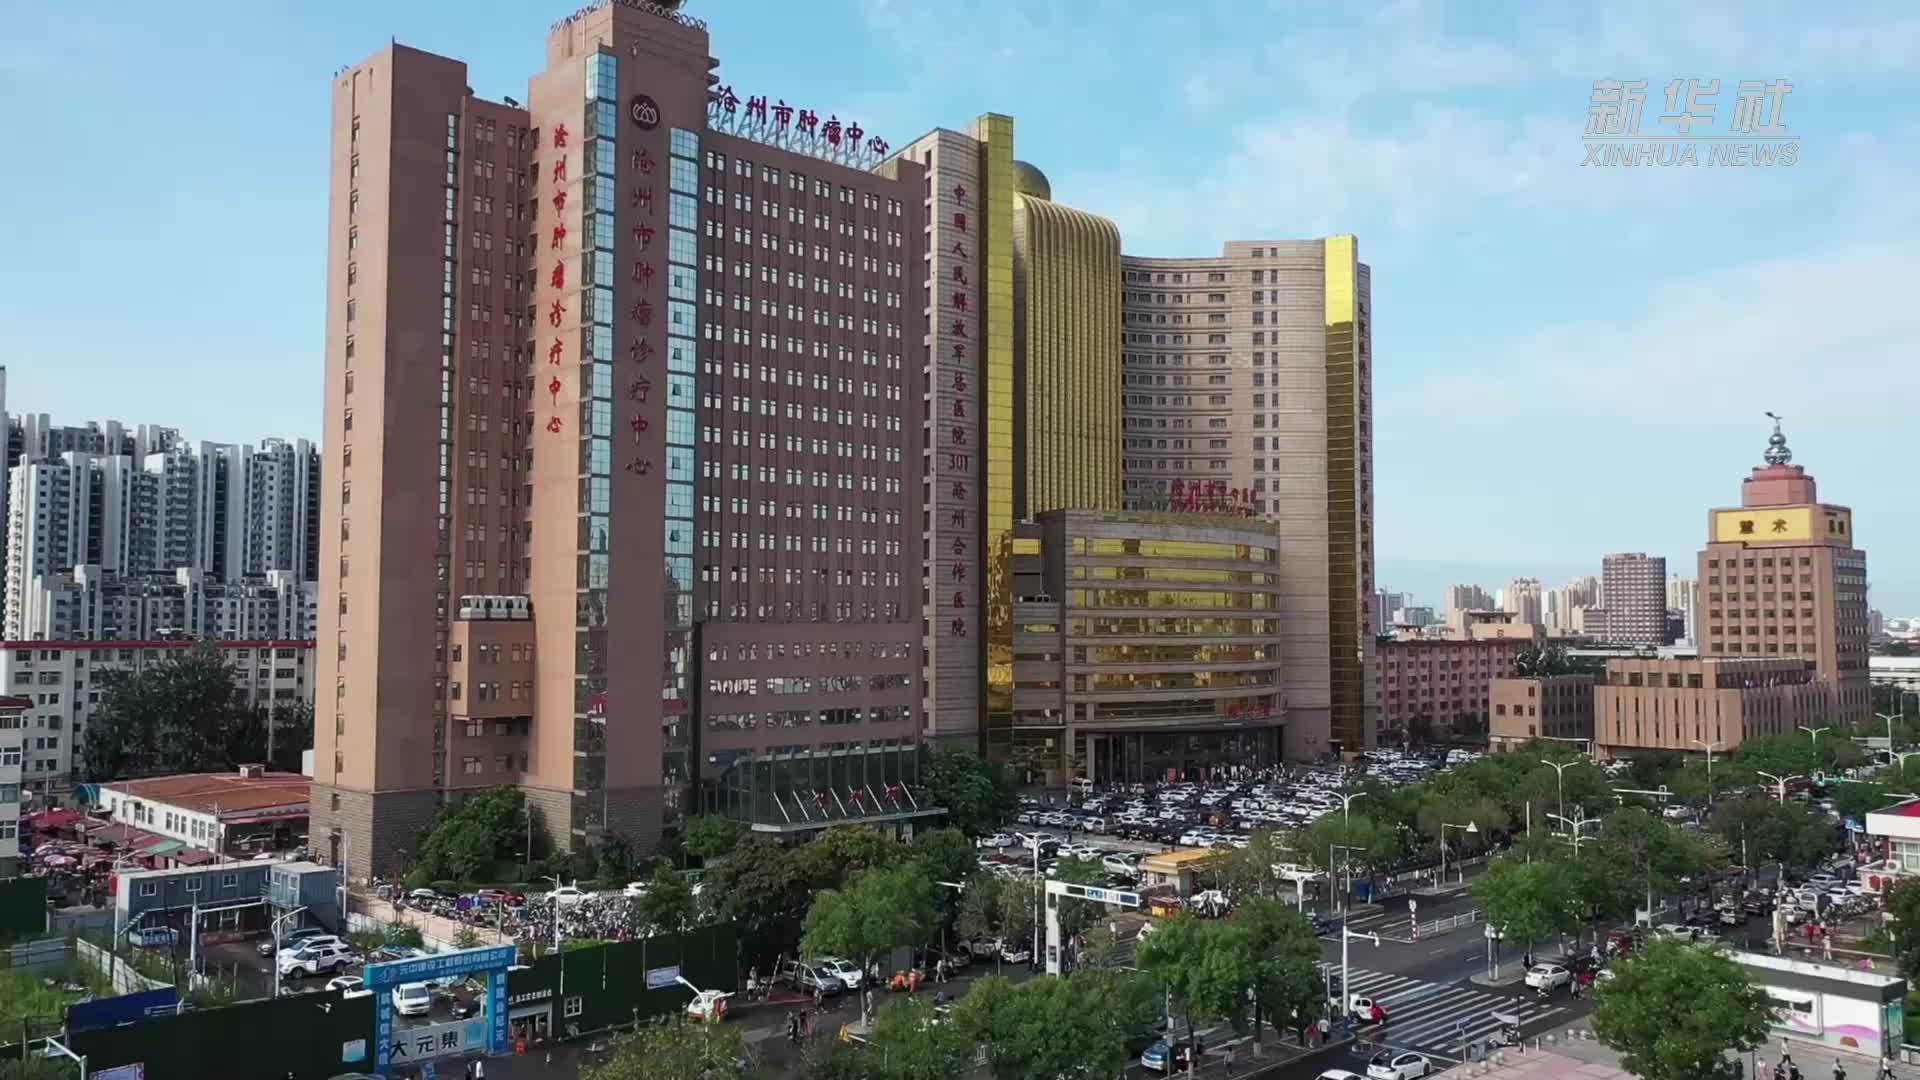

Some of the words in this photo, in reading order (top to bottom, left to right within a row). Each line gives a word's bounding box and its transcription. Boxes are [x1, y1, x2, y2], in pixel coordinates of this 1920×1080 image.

[715, 85, 889, 155] 沧州市肿瘤中心
[546, 122, 569, 433] 沧州市肿瘤诊疗中心
[625, 146, 656, 475] 沧州市肿瘤诊疗中心
